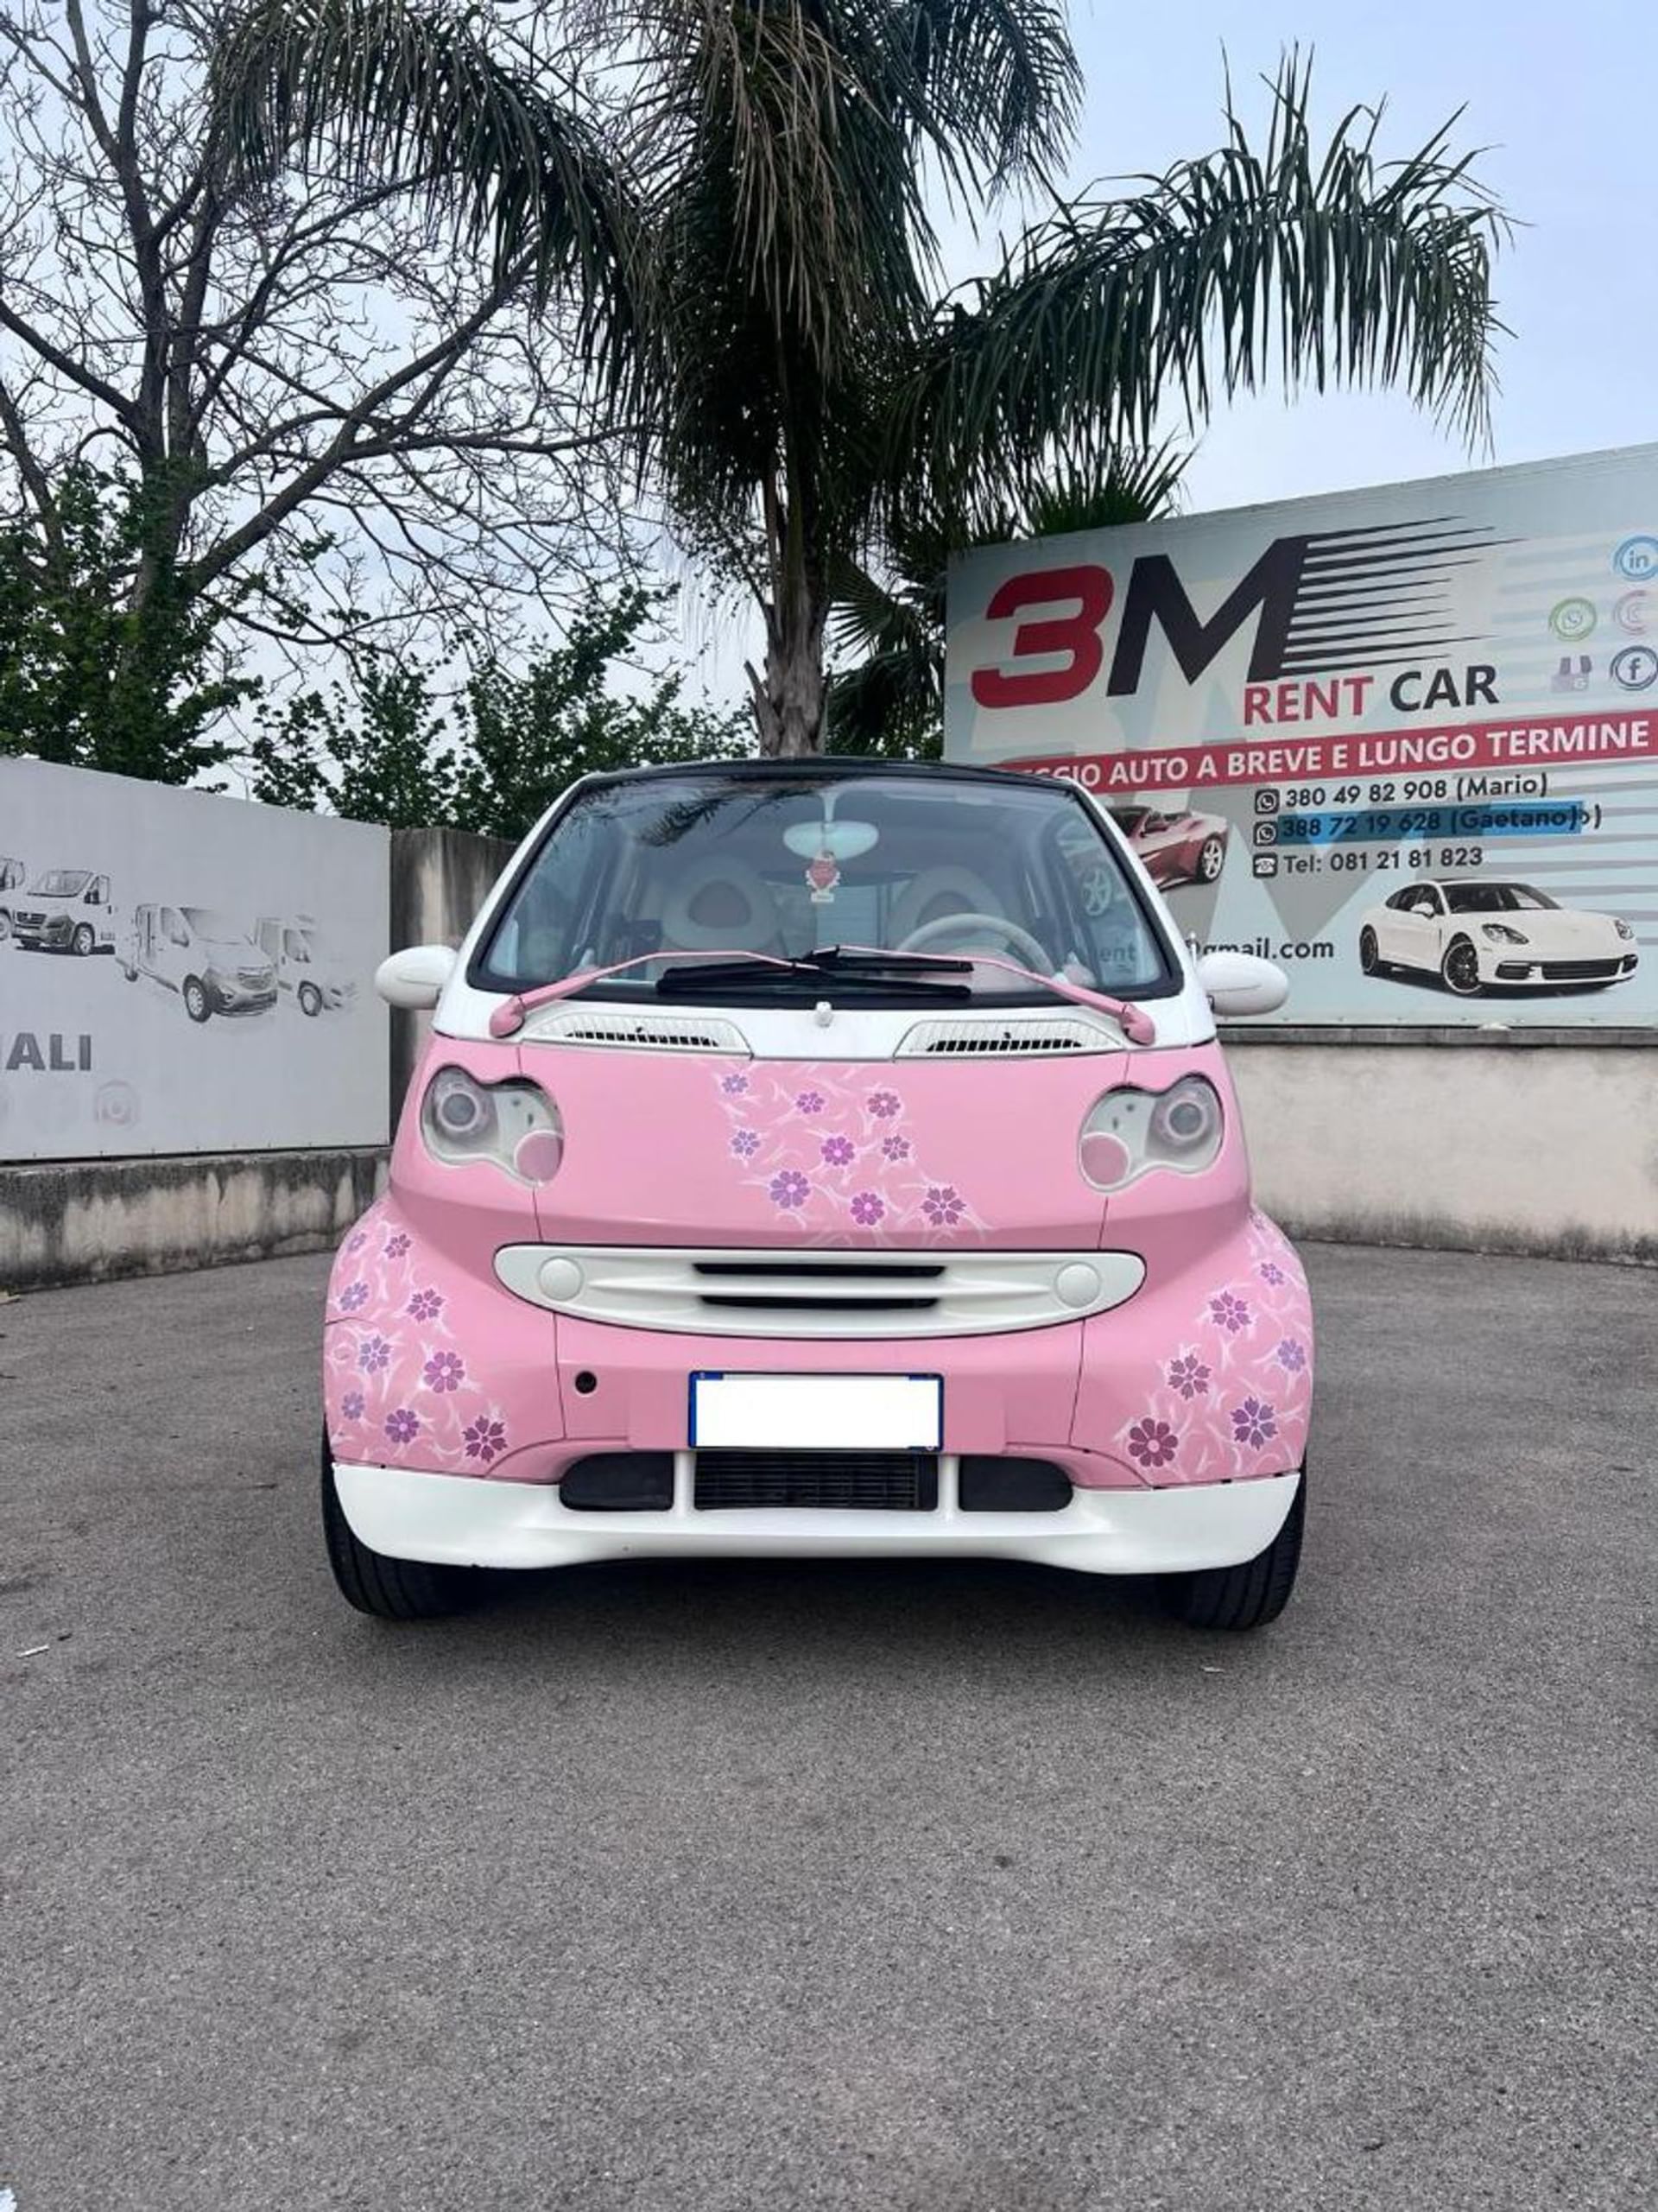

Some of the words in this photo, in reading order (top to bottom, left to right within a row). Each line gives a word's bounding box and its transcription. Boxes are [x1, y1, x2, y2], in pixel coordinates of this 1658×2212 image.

[971, 529, 1313, 708] 3M
[1244, 675, 1374, 726] RENT
[1389, 664, 1500, 713] CAR
[1022, 764, 1101, 787] GIO
[1109, 757, 1188, 785] AUTO
[1197, 755, 1218, 779] A
[1227, 747, 1322, 776] BREVE
[1332, 744, 1349, 770] E
[1358, 734, 1477, 767] LUNGO
[1486, 720, 1649, 757] TERMINE
[1286, 787, 1326, 807] 380
[1333, 785, 1361, 804] 49
[1369, 783, 1395, 802] 82
[1403, 780, 1447, 800] 908
[1457, 772, 1547, 802] (Mario)
[1283, 818, 1322, 837] 388
[1329, 816, 1357, 835] 72
[1368, 814, 1390, 833] 19
[1399, 811, 1440, 831] 628
[1283, 854, 1322, 874] Tel:
[1330, 852, 1368, 871] 081
[1376, 850, 1400, 869] 21
[1408, 848, 1432, 868] 81
[1440, 846, 1484, 867] 823
